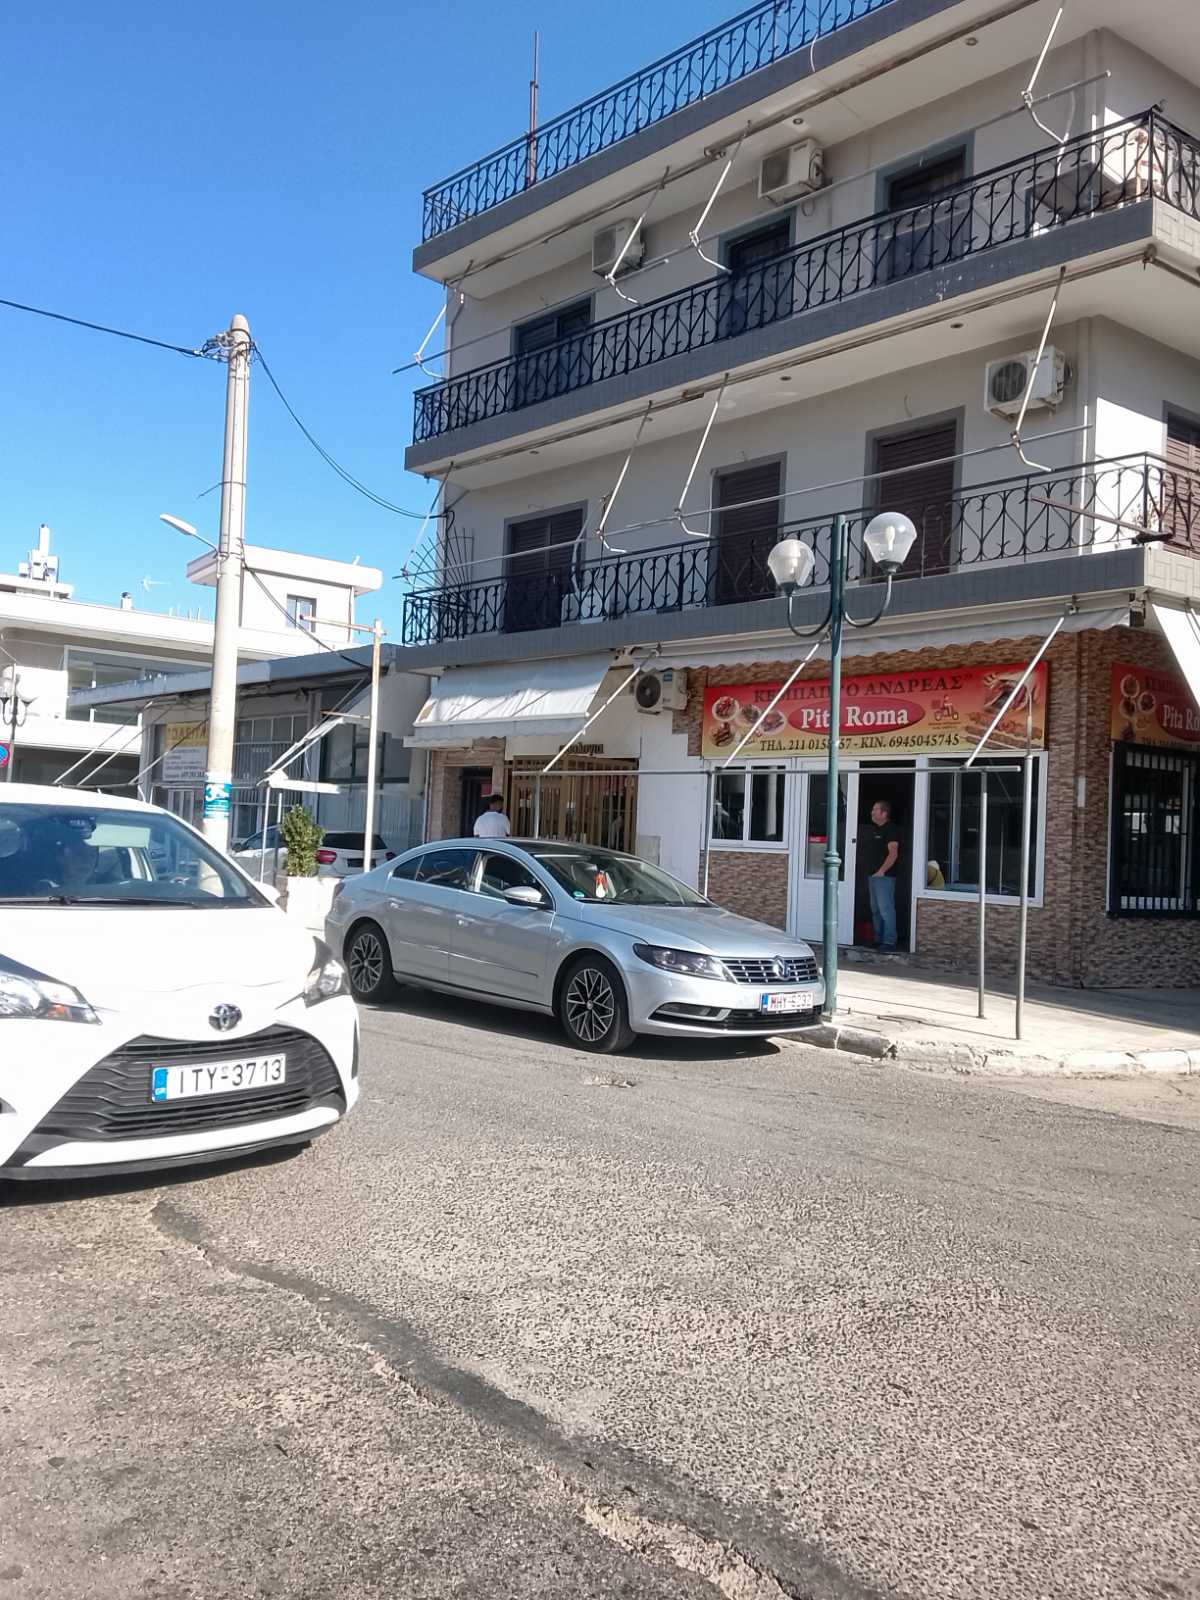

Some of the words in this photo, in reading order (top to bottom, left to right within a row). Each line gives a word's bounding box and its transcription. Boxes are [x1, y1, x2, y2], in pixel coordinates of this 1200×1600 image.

[800, 706, 832, 729] Pit
[845, 704, 909, 728] Roma
[1162, 703, 1184, 729] Pita
[788, 739, 805, 751] 211
[860, 736, 886, 749] ΚΙΝ.
[888, 732, 960, 749] 6945045745
[179, 1058, 282, 1094] ITY-3713
